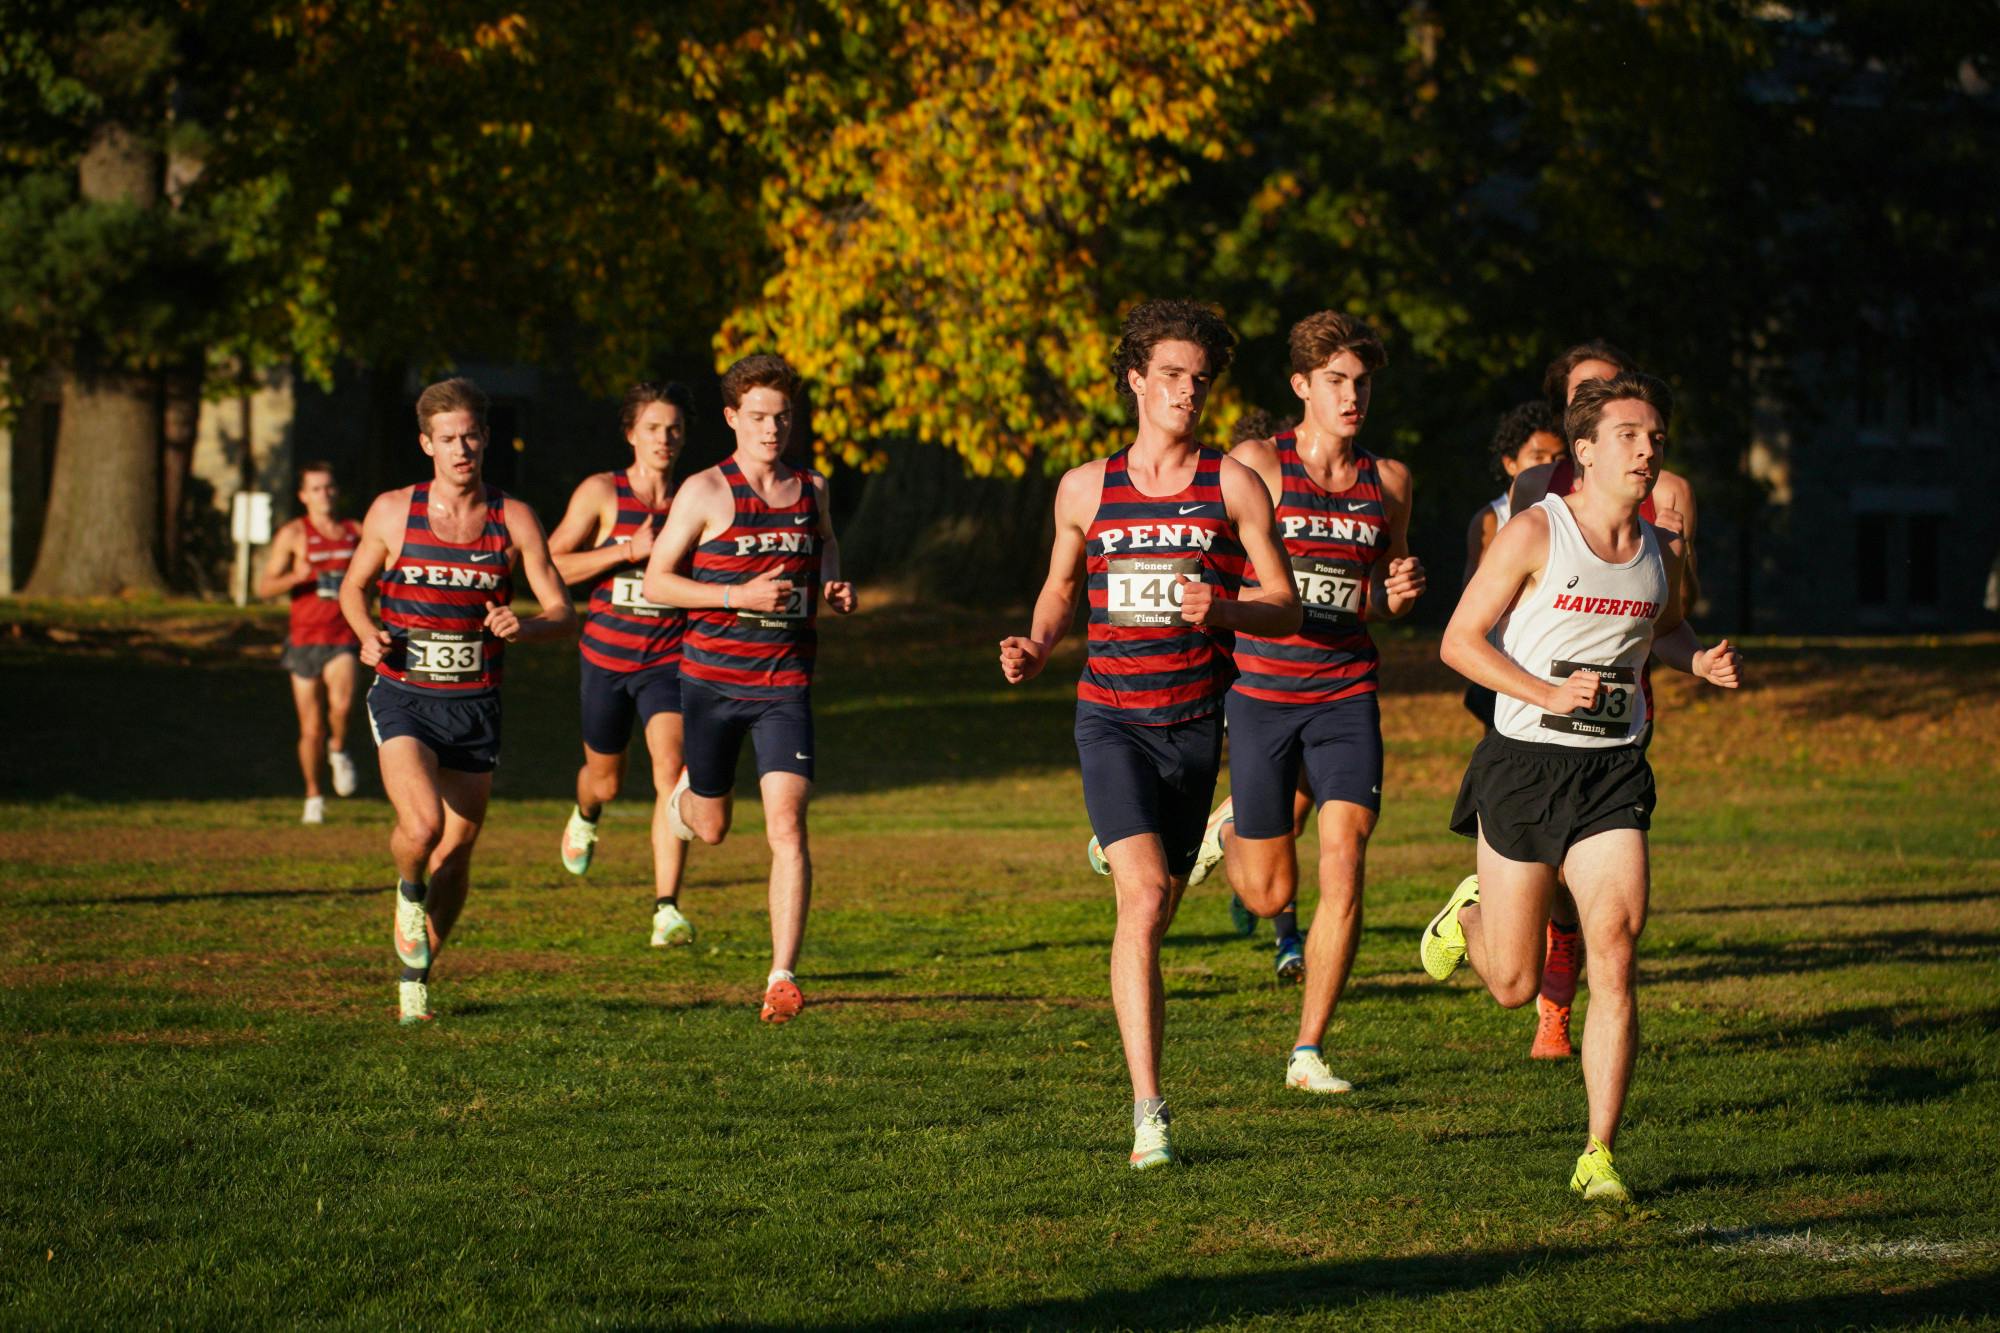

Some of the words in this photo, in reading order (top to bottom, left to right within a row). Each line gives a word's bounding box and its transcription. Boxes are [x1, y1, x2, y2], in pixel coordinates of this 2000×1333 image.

[1281, 515, 1380, 546] PENN
[735, 532, 814, 556] PENN
[1098, 524, 1217, 555] PENN
[1134, 562, 1173, 571] Pioneer
[1315, 563, 1346, 575] Pioneer
[401, 565, 501, 590] PENN
[1299, 577, 1356, 608] 137
[1553, 594, 1660, 619] HAVERFORD
[1134, 614, 1171, 624] Timing
[1308, 609, 1338, 622] Timing
[760, 620, 788, 629] Timing
[431, 632, 463, 641] Pioneer
[416, 646, 475, 669] 133
[429, 674, 459, 682] Timing
[1572, 721, 1606, 735] Timing
